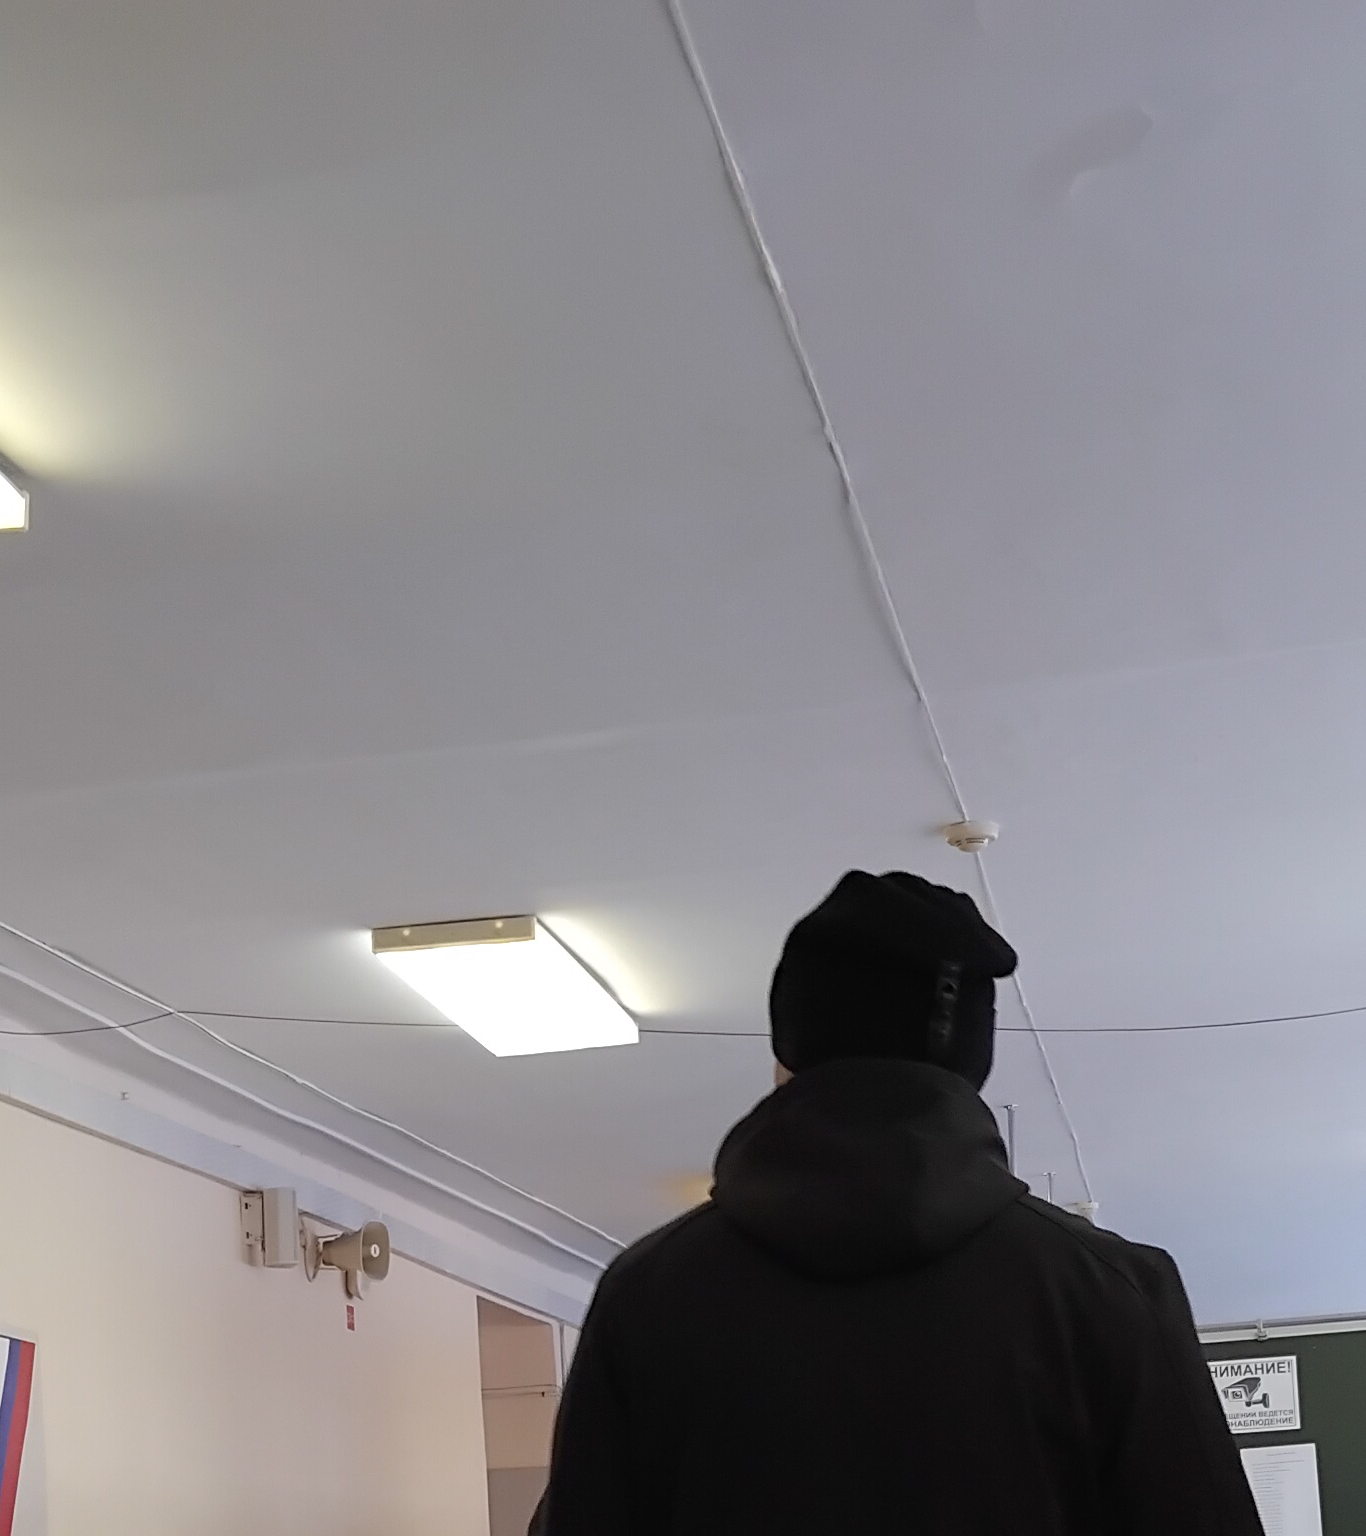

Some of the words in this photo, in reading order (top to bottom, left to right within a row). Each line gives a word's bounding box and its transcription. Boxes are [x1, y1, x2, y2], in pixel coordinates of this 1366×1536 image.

[1210, 1361, 1291, 1378] НИМАНИЕ!
[1226, 1411, 1257, 1420] ЩЕНИИ
[1258, 1409, 1294, 1417] ВЕДЕТСЯ
[1227, 1417, 1294, 1428] НАБЛЮДЕНИЕ
